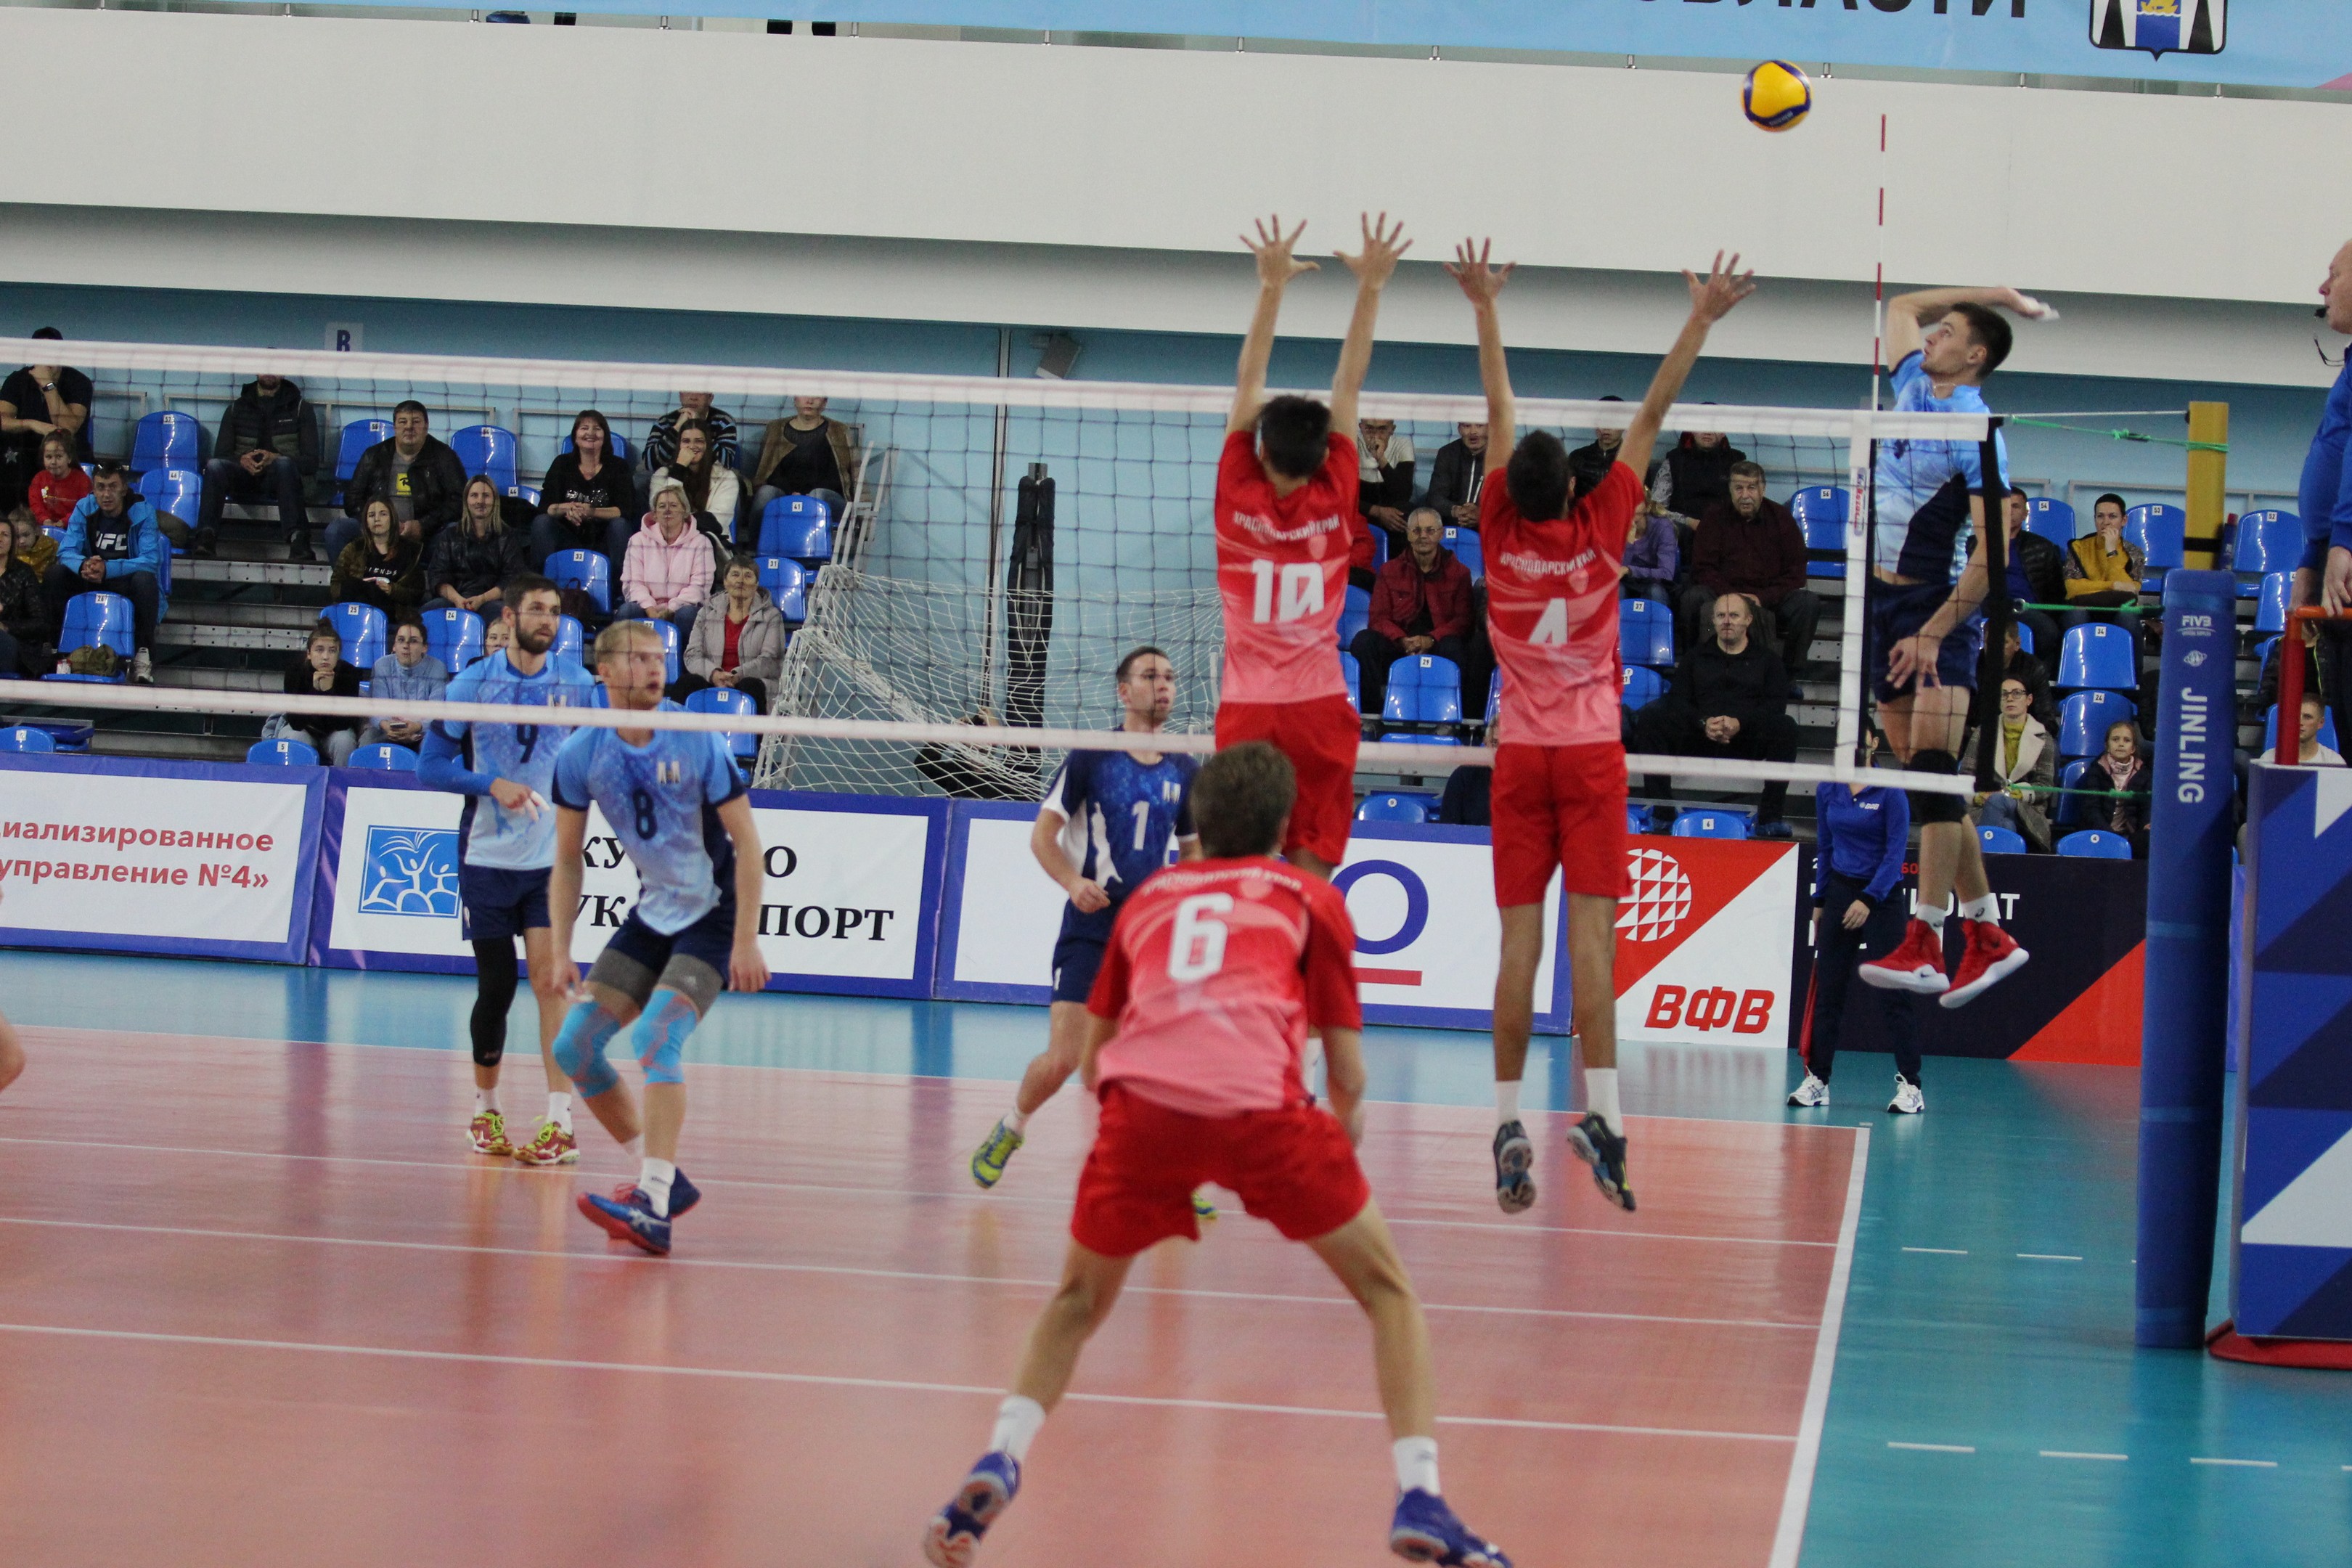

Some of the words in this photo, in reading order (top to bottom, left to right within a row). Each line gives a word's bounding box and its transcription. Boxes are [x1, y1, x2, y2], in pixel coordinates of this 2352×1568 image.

[1251, 559, 1324, 624] 10
[1528, 597, 1569, 646] 4
[2181, 615, 2212, 627] FIVB
[516, 723, 539, 764] 9
[2178, 687, 2208, 804] JINLING
[0, 821, 274, 852] иализированное
[632, 787, 658, 840] 8
[1132, 800, 1150, 851] 1
[0, 859, 189, 885] управление
[763, 846, 797, 878] О
[758, 905, 894, 942] ПОРТ
[1167, 892, 1235, 981] 6
[1644, 984, 1776, 1034] ВФВ
